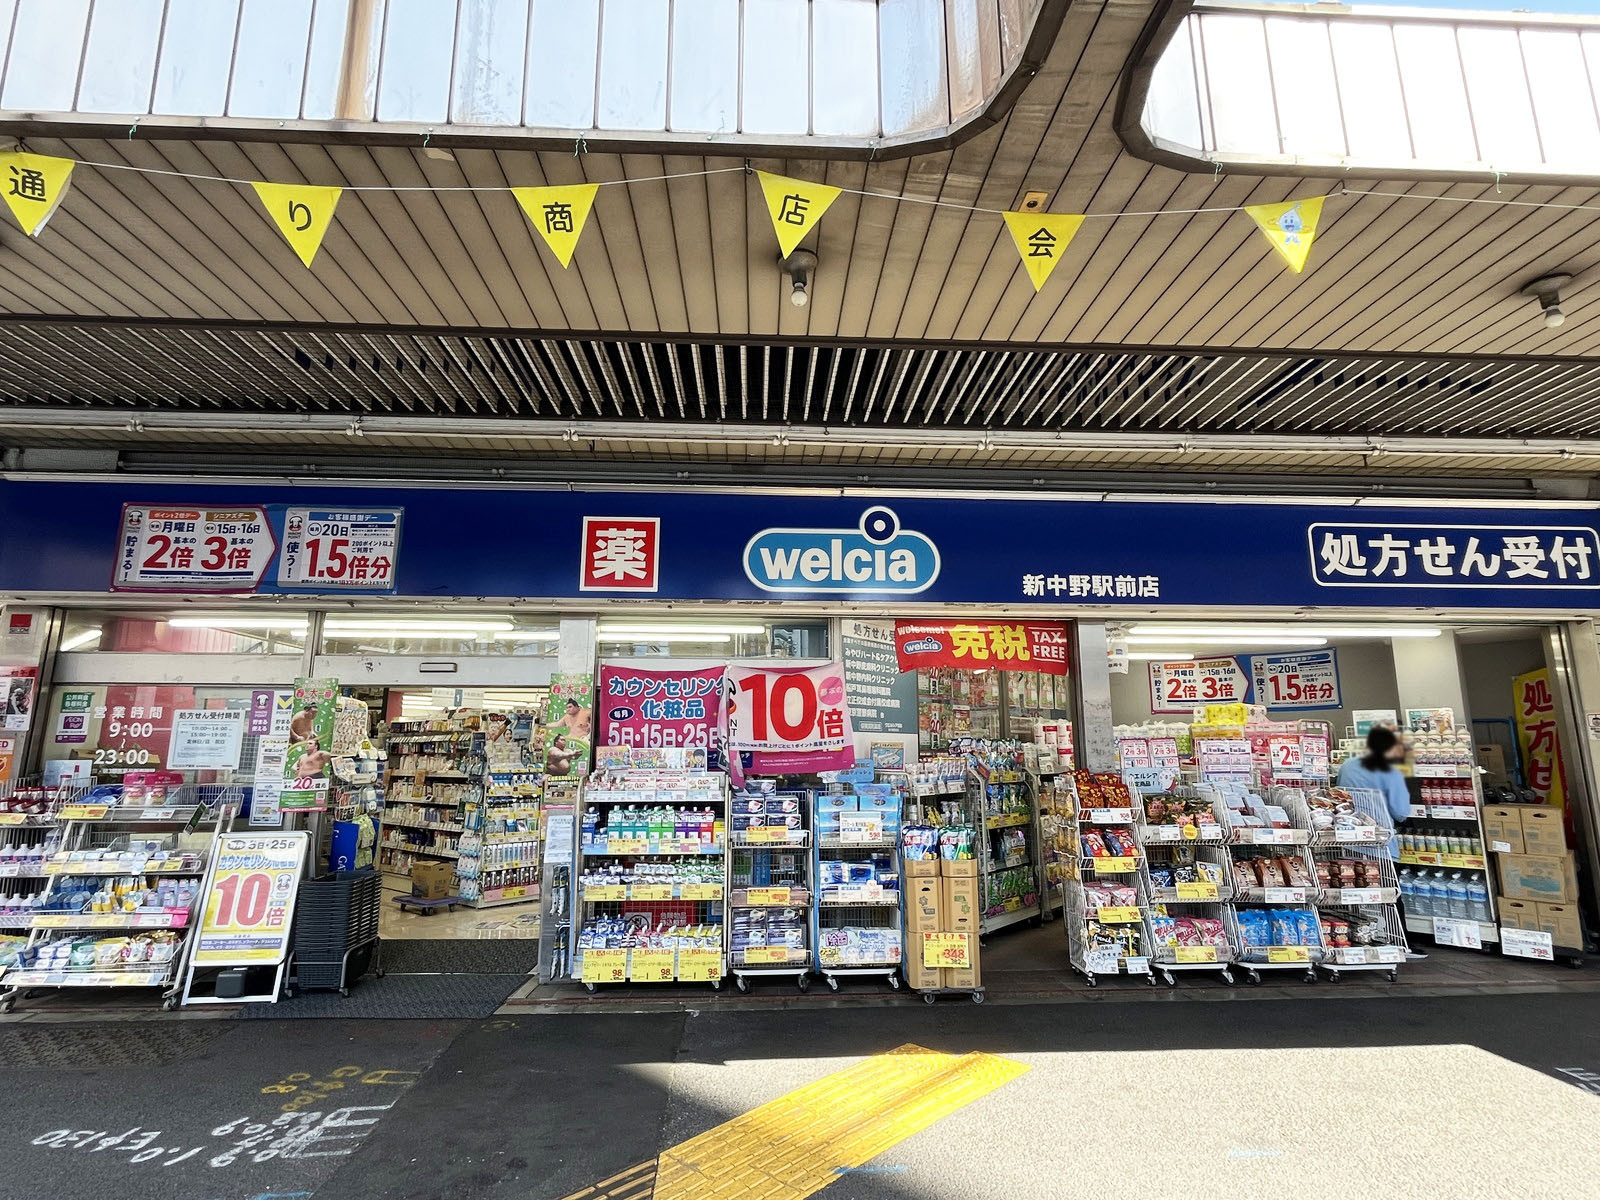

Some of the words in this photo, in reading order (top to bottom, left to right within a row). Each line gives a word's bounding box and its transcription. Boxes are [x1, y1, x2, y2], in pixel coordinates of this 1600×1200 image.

[9, 165, 47, 201] 通
[290, 202, 313, 232] り
[543, 201, 574, 234] 商
[779, 195, 811, 227] 店
[1027, 227, 1058, 259] 会
[161, 521, 196, 533] 月曜日
[321, 523, 349, 537] 20日
[173, 536, 197, 545] 基本の
[230, 537, 254, 545] 基本の
[305, 538, 392, 580] 1.5倍分
[592, 527, 648, 581] 薬
[759, 538, 917, 582] welcia
[1320, 532, 1594, 580] 処方せん受付
[1022, 573, 1160, 598] 新中野駅前店
[949, 624, 1031, 662] 免税
[1031, 631, 1062, 644] TAX
[1032, 644, 1066, 659] FREE
[1173, 669, 1195, 677] 月曜日
[1278, 664, 1298, 674] 20日
[1268, 673, 1335, 702] 1.5倍分
[93, 705, 164, 720] 営業時間
[178, 712, 241, 720] 処方せん受付時間
[640, 699, 706, 720] 化粧品
[109, 722, 154, 738] 9:00
[93, 749, 149, 765] 23:00
[946, 949, 965, 959] 348
[612, 969, 623, 977] 98
[660, 968, 671, 976] 98
[707, 967, 718, 975] 98
